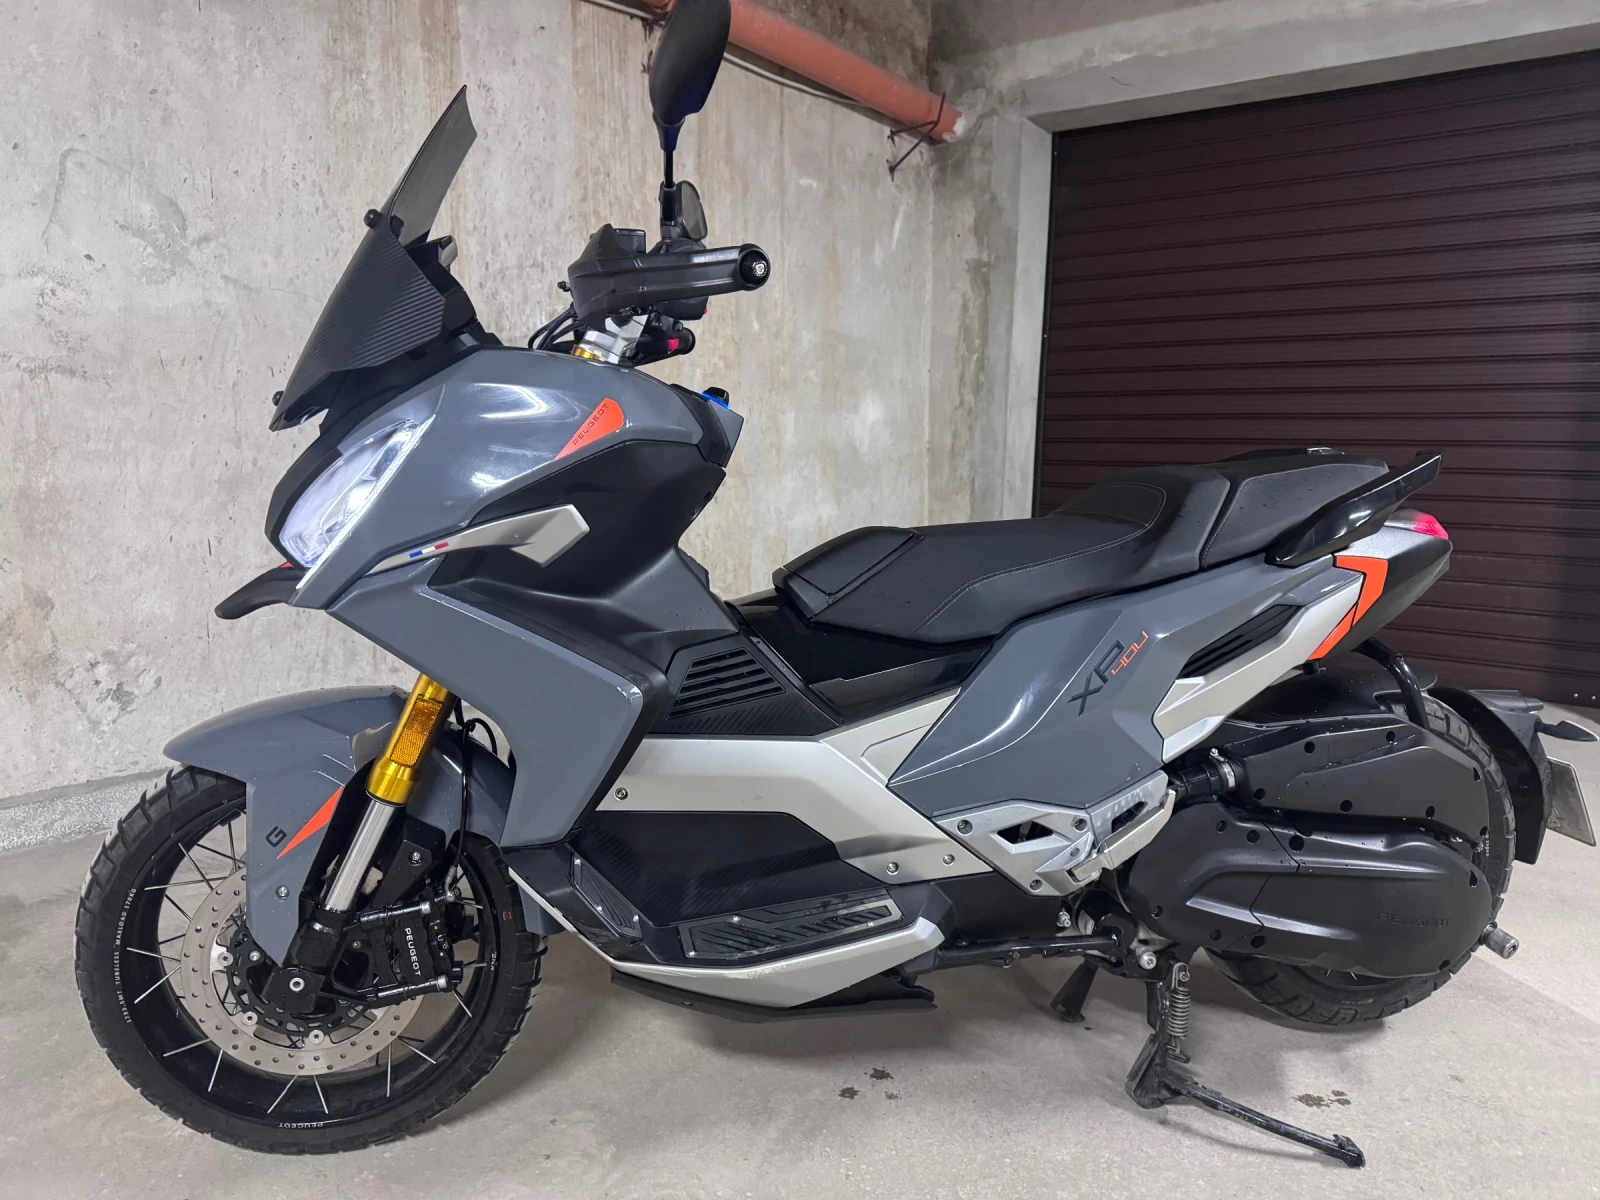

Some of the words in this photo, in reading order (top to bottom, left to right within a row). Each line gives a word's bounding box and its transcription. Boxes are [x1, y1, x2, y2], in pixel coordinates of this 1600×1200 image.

[573, 403, 608, 446] PEUGEOT
[113, 951, 121, 985] TUBELESS
[404, 927, 421, 977] PEUGEOT
